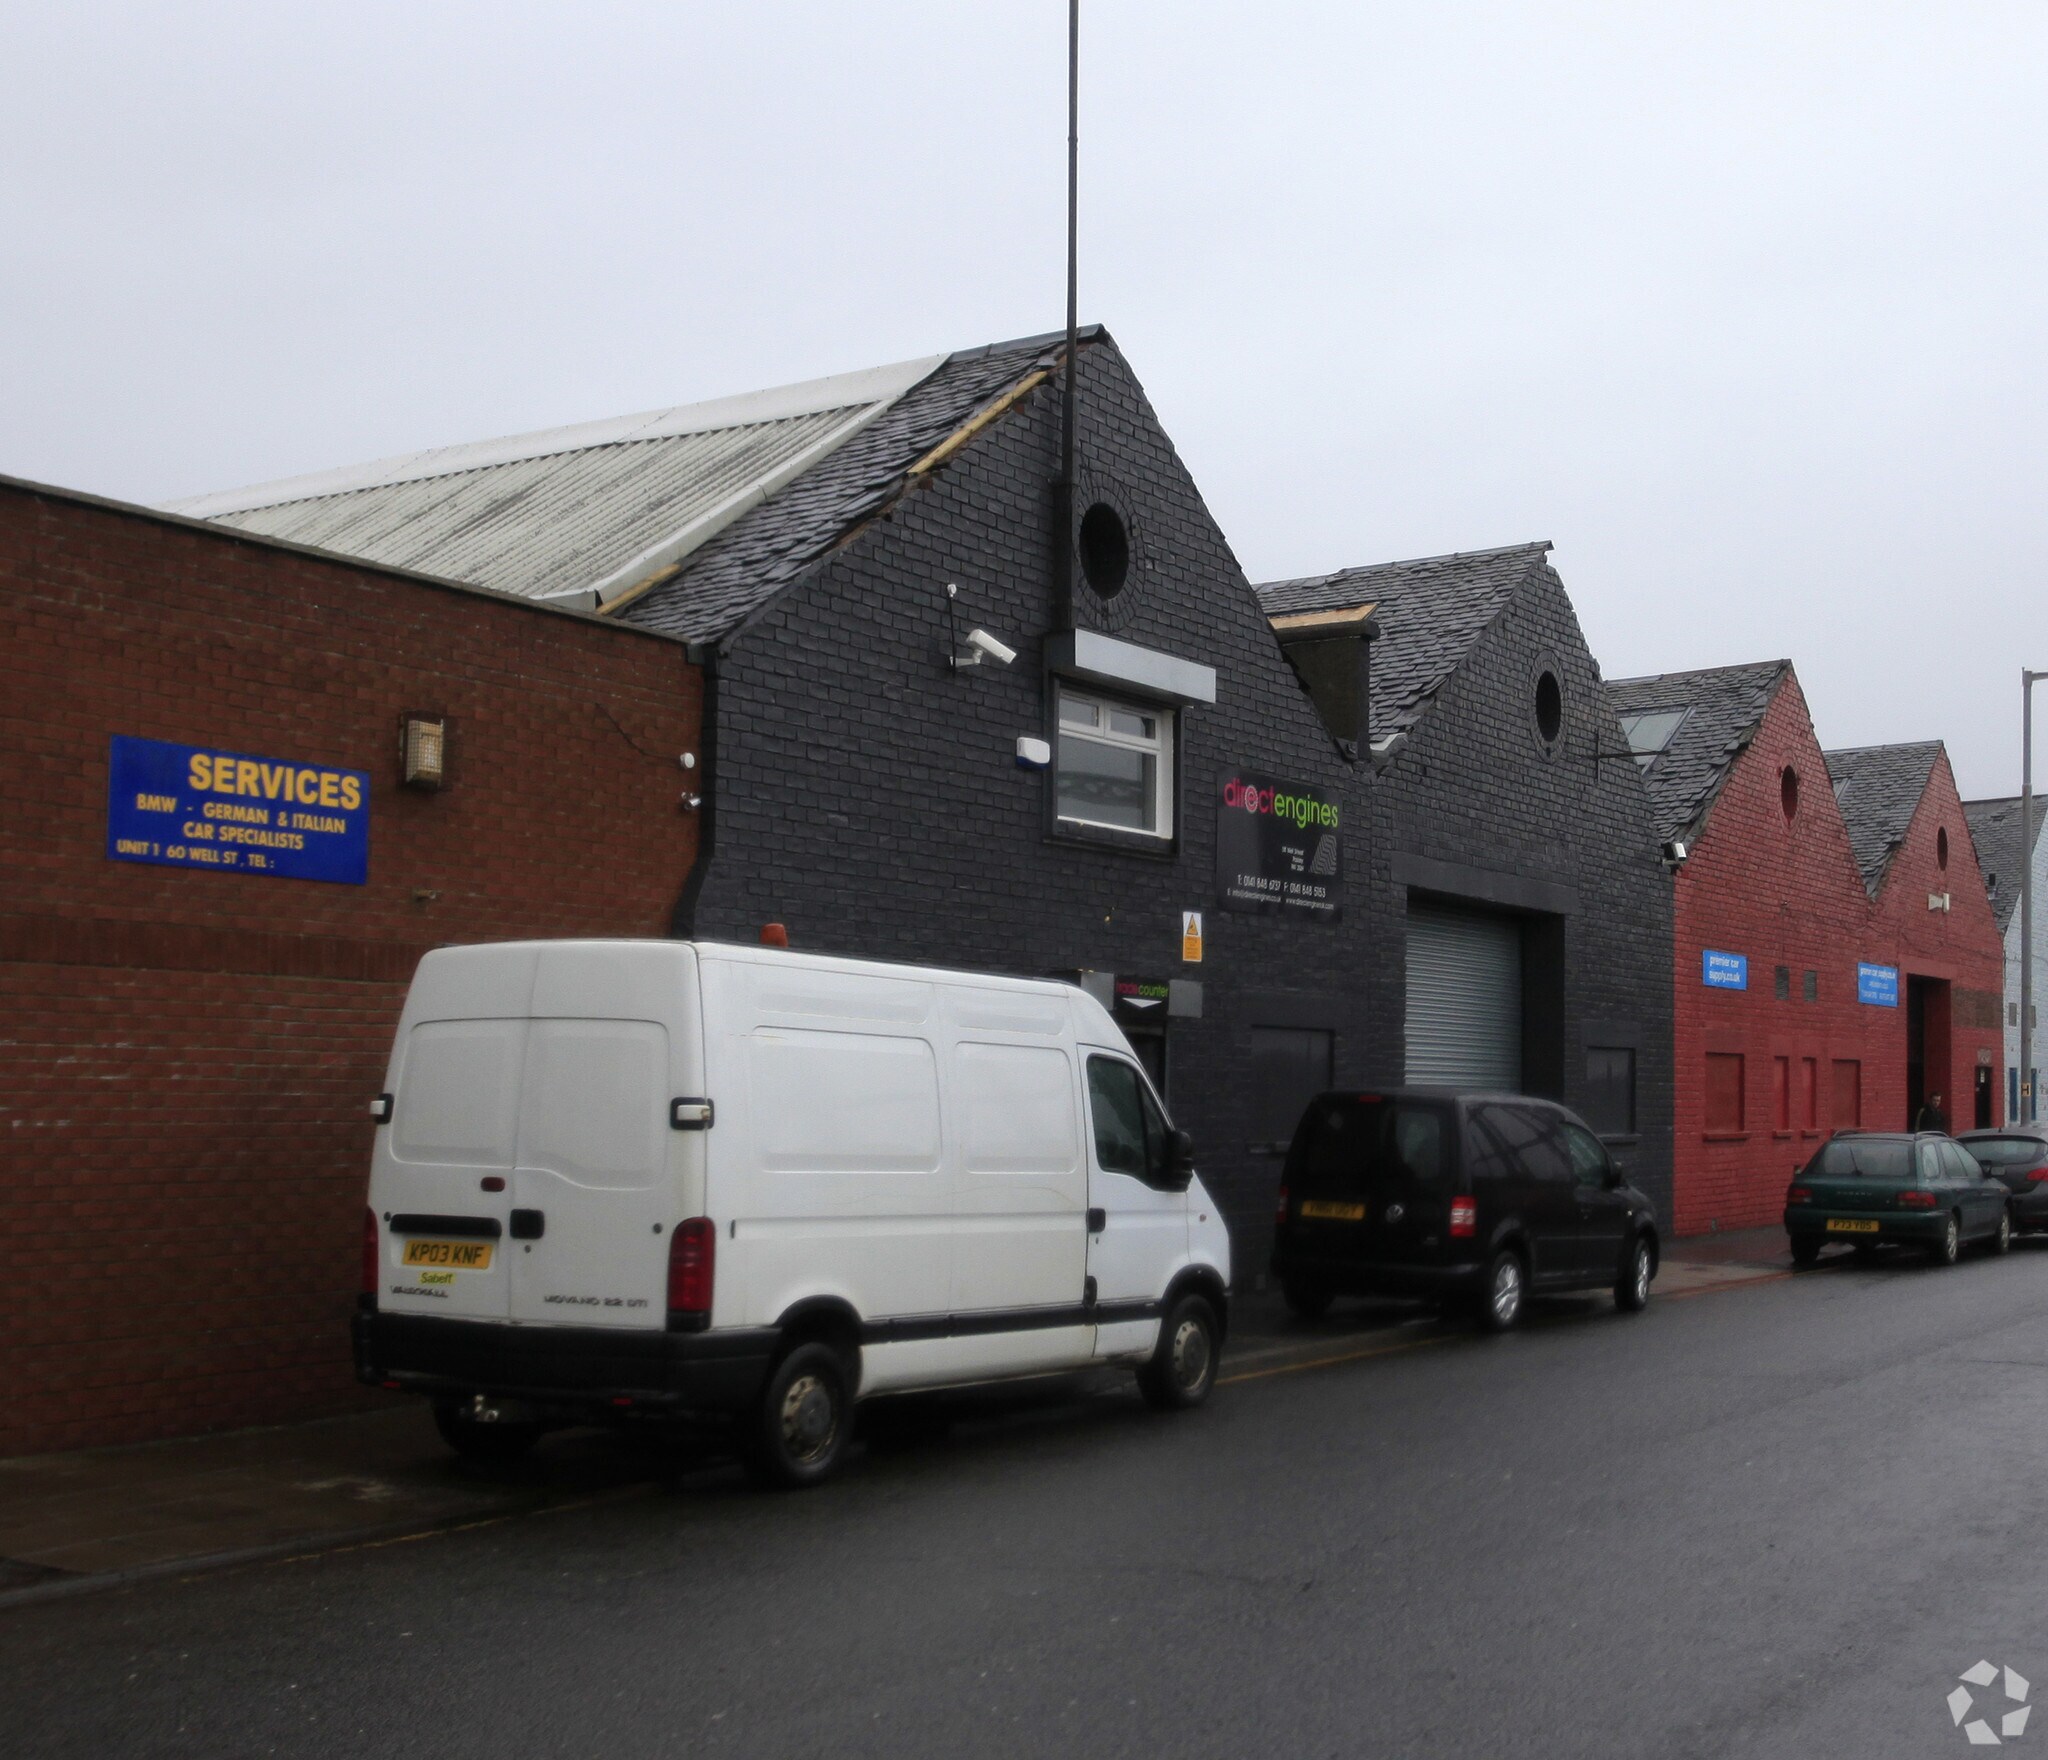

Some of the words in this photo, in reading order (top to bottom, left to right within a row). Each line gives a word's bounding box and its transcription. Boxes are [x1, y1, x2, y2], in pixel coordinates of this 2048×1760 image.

[188, 753, 361, 811] SERVICES
[135, 793, 177, 814] BMW
[203, 801, 269, 825] GERMAN
[277, 811, 288, 827] &
[292, 813, 345, 834] ITALIAN
[183, 821, 214, 840] CAR
[219, 825, 304, 850] SPECIALISTS
[116, 839, 149, 855] UNIT
[153, 842, 160, 856] 1
[167, 845, 185, 859] 60
[189, 847, 219, 863] WELL
[409, 1243, 449, 1262] KP03
[451, 1245, 485, 1265] KNF
